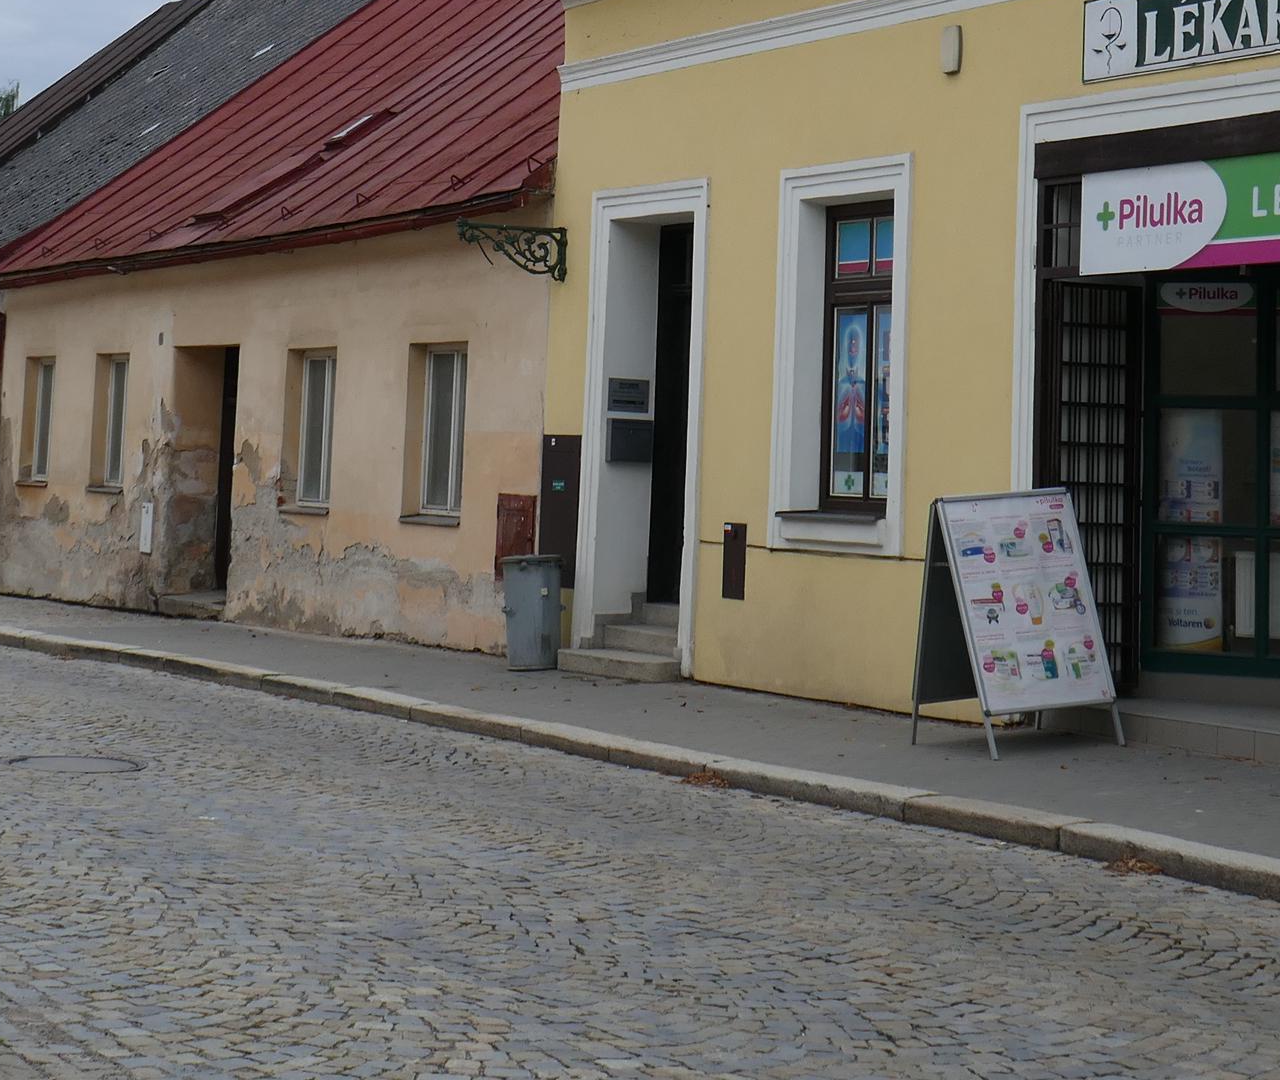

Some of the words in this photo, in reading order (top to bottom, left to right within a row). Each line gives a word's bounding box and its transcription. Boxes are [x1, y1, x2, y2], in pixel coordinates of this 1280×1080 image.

[1118, 192, 1204, 231] Pilulka
[1116, 231, 1183, 248] PARTNER
[1188, 286, 1239, 301] Pilulka
[1168, 617, 1203, 628] Voltaren
